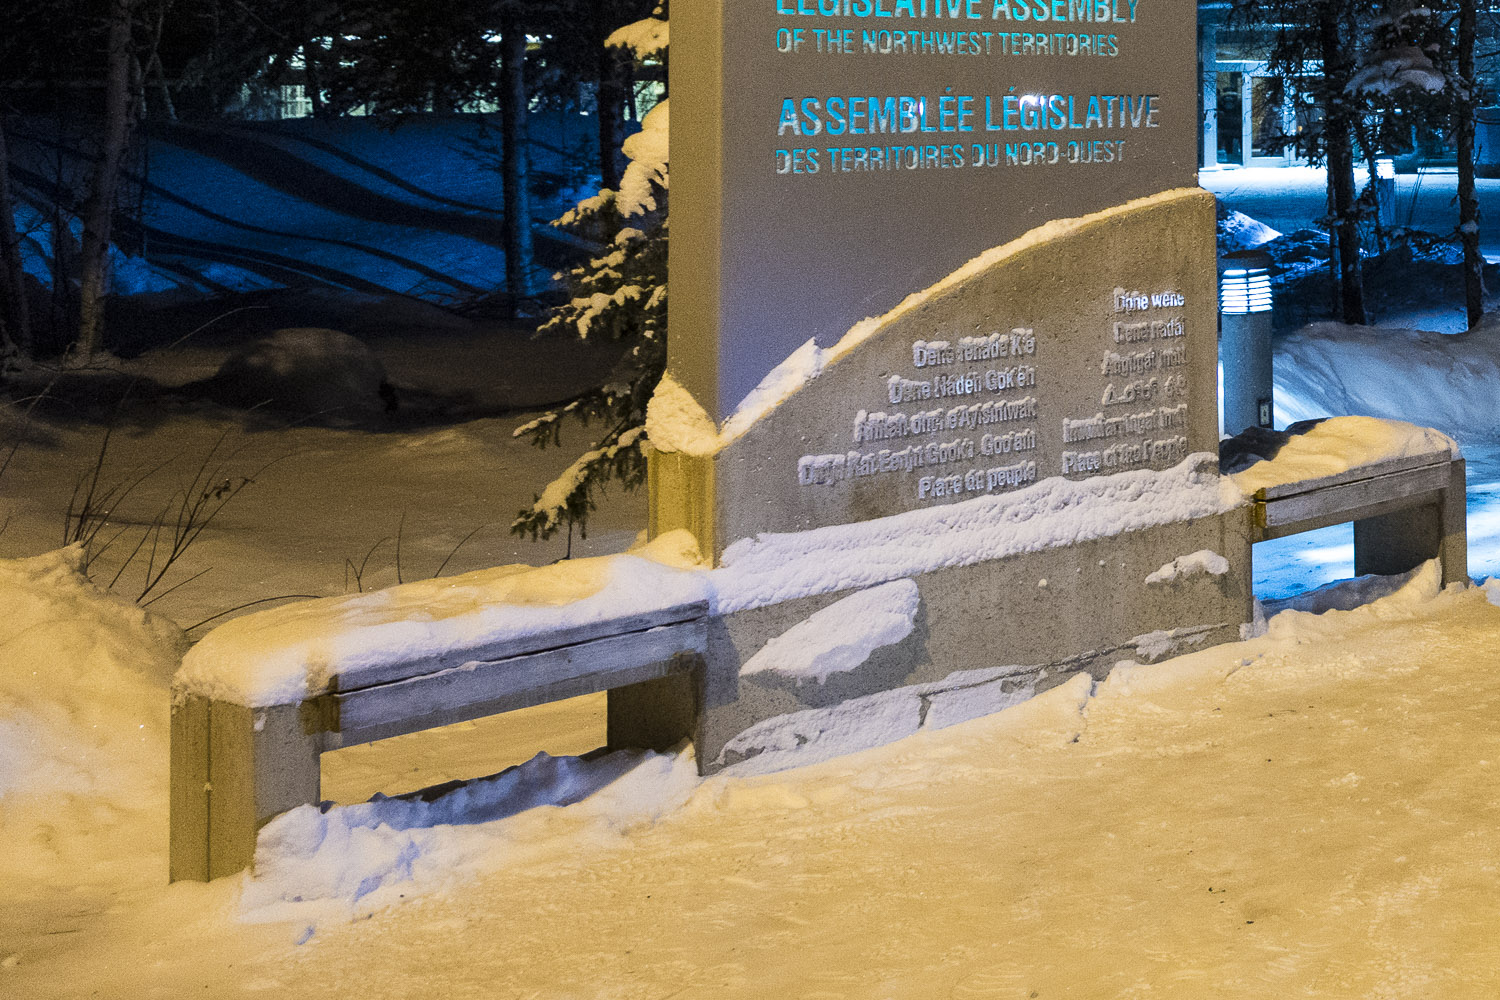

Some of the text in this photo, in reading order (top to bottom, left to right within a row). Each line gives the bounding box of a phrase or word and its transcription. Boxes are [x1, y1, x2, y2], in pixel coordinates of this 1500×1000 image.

[776, 28, 1119, 57] OF THE NORTHWEST TERRITORIES
[777, 85, 1160, 136] ASSEMBLÉE LÉGISLATIVE
[776, 140, 1126, 174] DES TERRITOIRES DU NORD-OUEST
